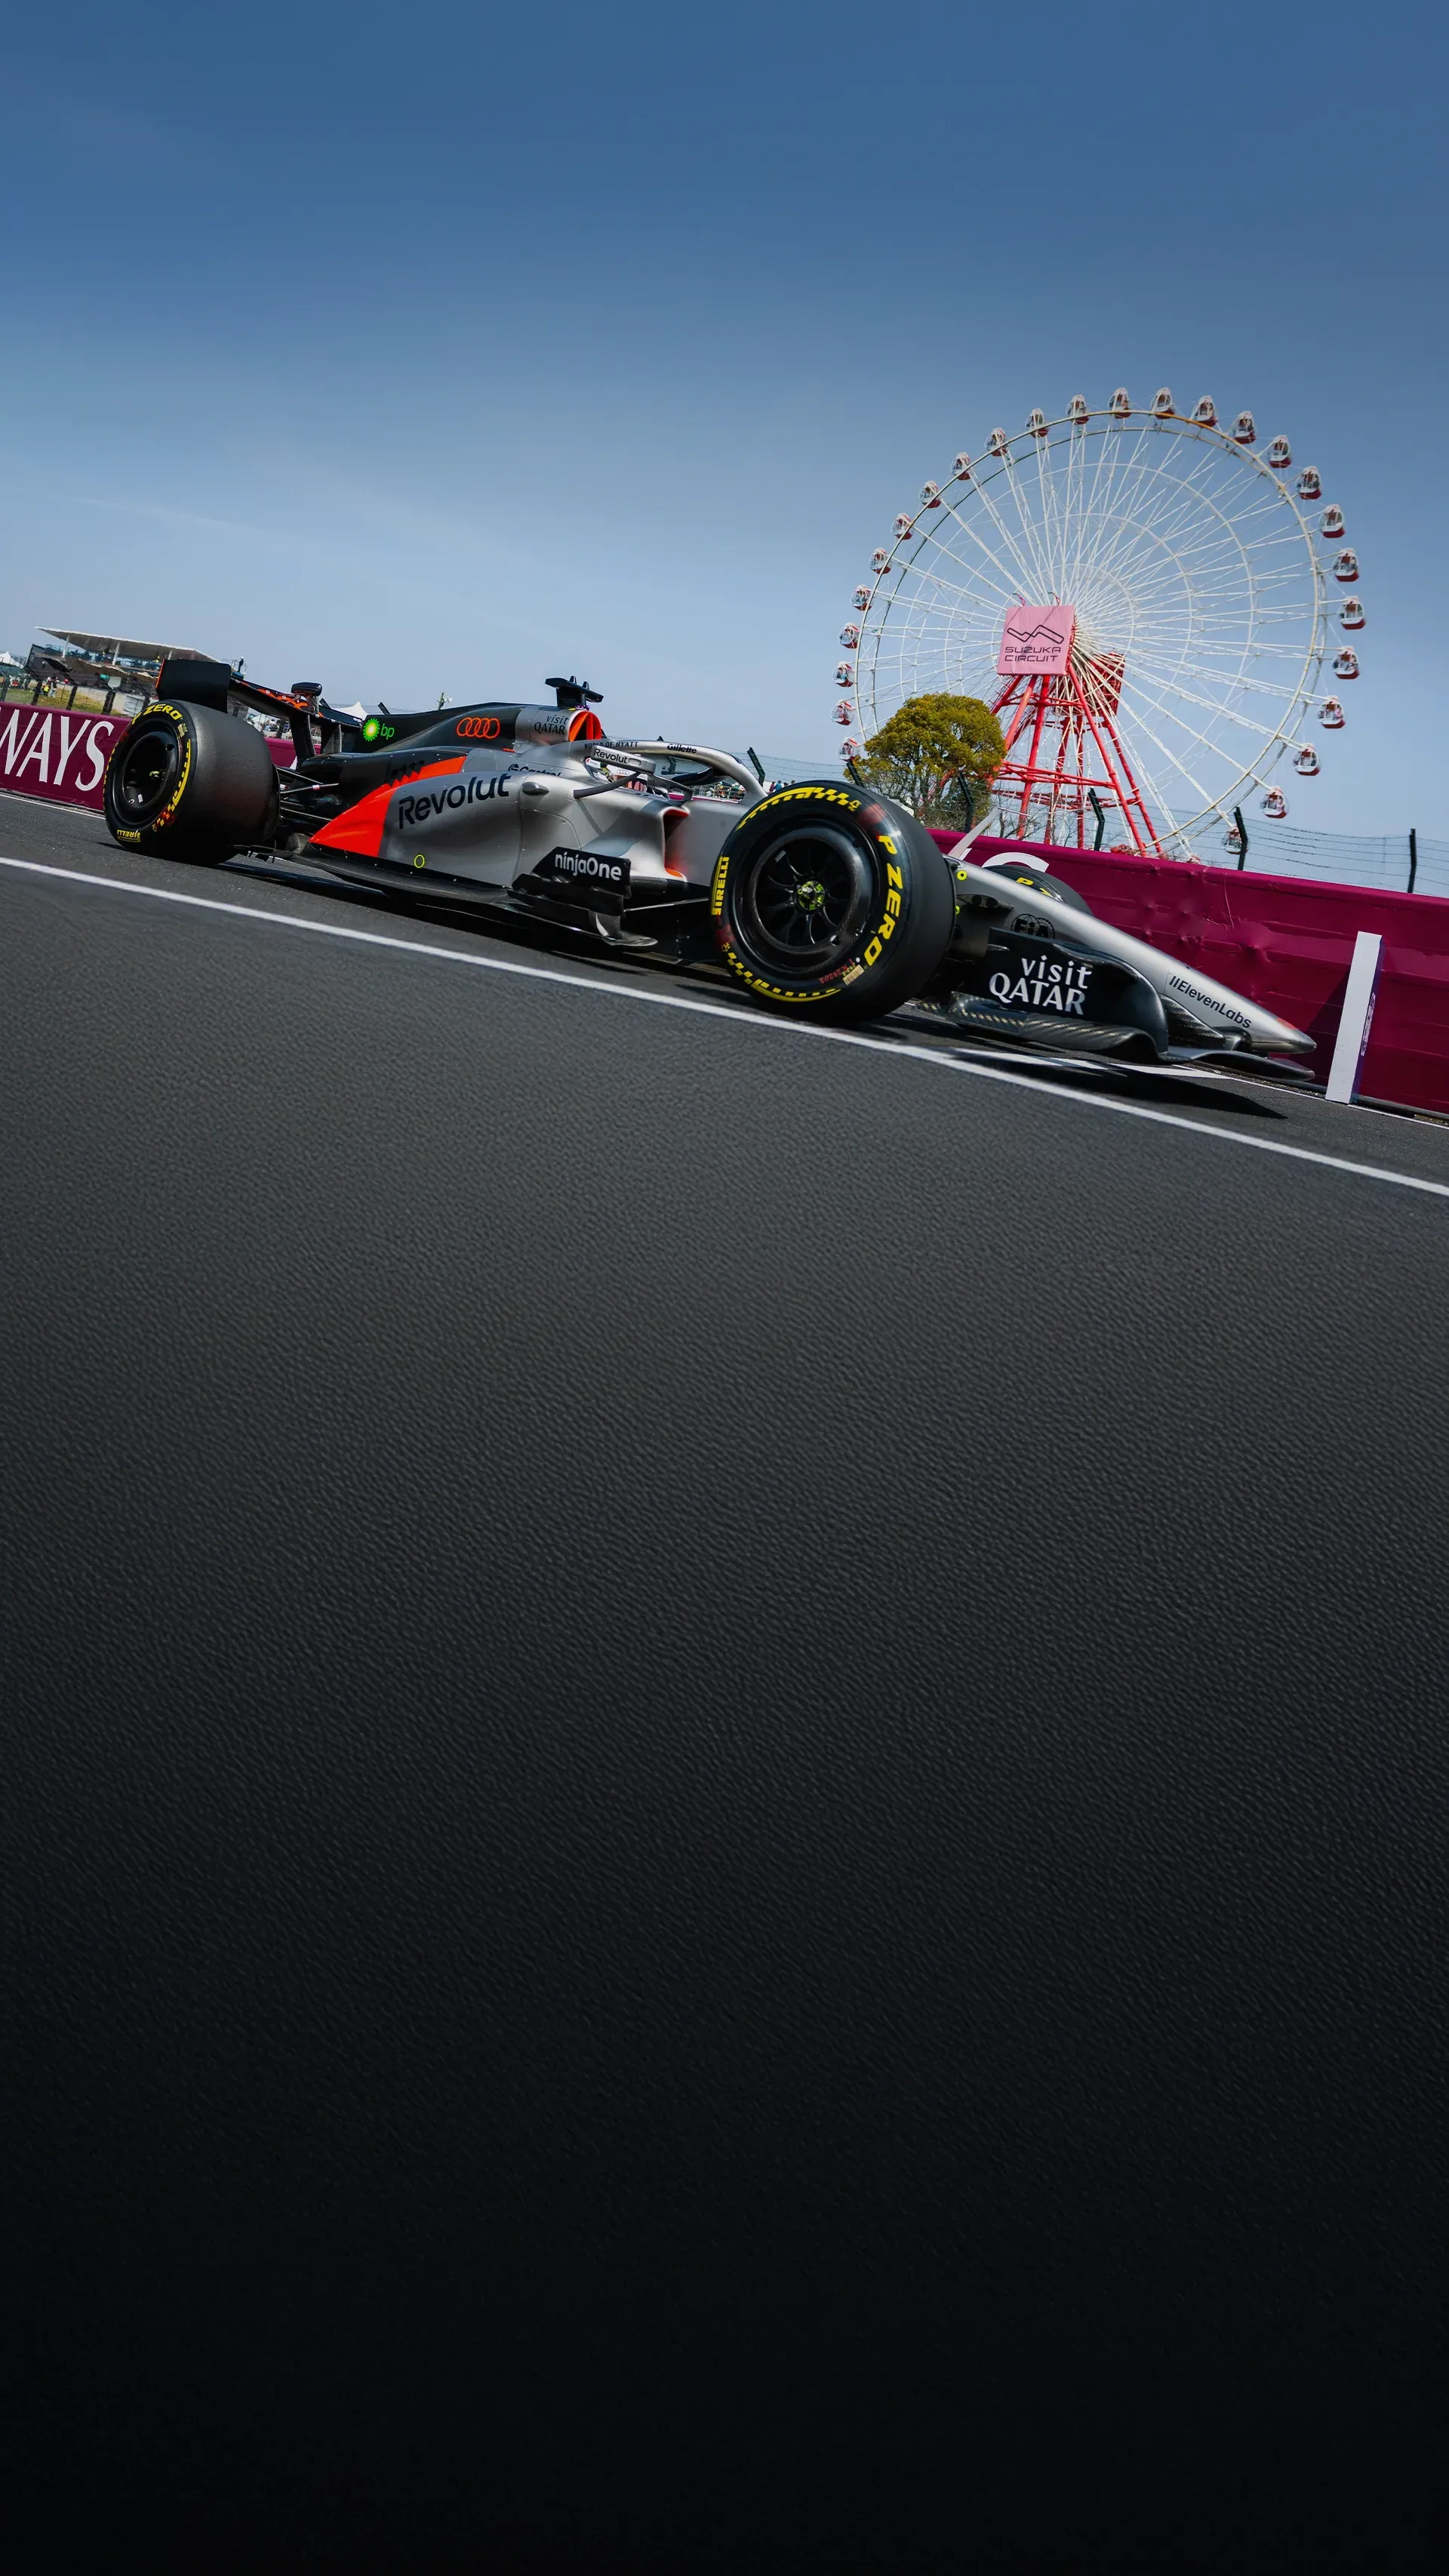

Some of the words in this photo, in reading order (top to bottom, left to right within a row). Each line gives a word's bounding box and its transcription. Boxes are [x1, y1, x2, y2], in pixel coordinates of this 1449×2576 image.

[143, 704, 183, 720] ZERO
[546, 714, 569, 725] visit
[380, 723, 395, 740] bp
[534, 722, 565, 735] QATAR
[593, 748, 628, 764] Revolut
[666, 743, 697, 754] Gillette
[398, 773, 511, 830] Revolut
[878, 835, 897, 855] P
[555, 851, 622, 882] ninjaOne
[711, 856, 730, 916] PIRELLI
[863, 863, 903, 967] ZERO
[1021, 955, 1092, 989] visit
[989, 972, 1085, 1015] QATAR
